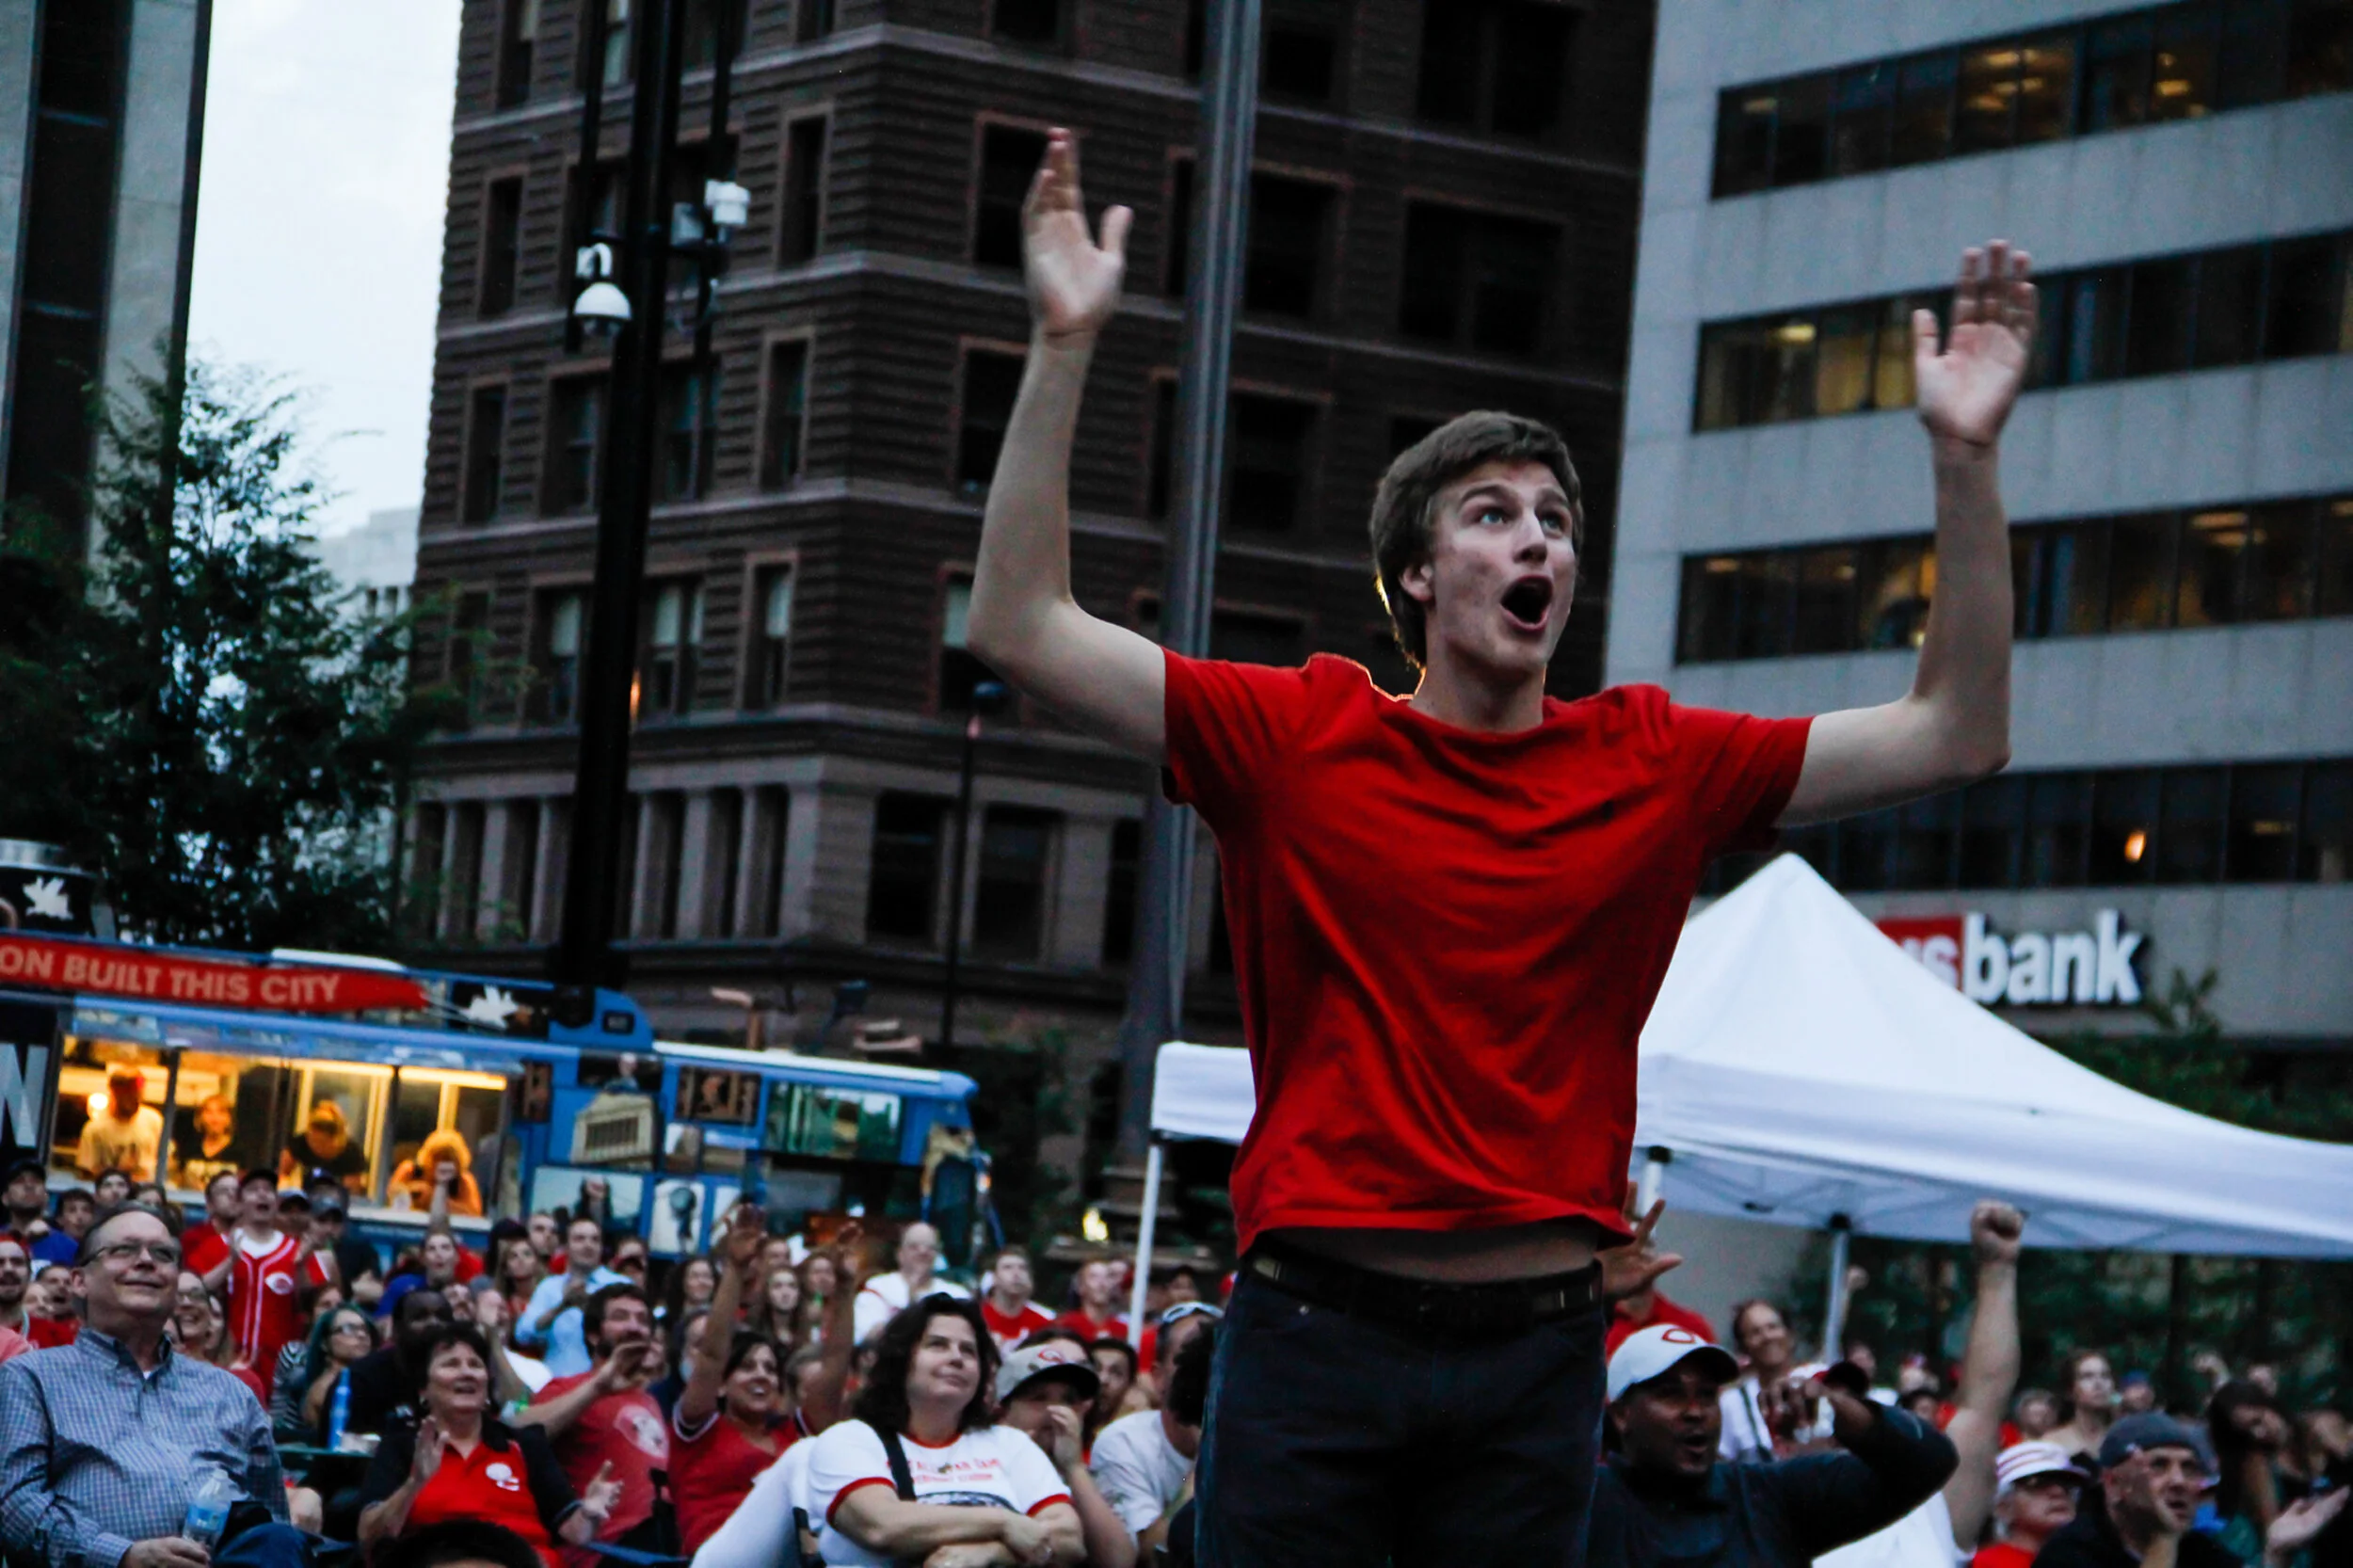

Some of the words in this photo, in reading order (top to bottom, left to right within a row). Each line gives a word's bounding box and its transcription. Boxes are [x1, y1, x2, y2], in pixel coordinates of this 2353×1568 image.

[63, 953, 161, 994] BUILT
[168, 968, 249, 1001] THIS
[260, 974, 340, 1004] CITY
